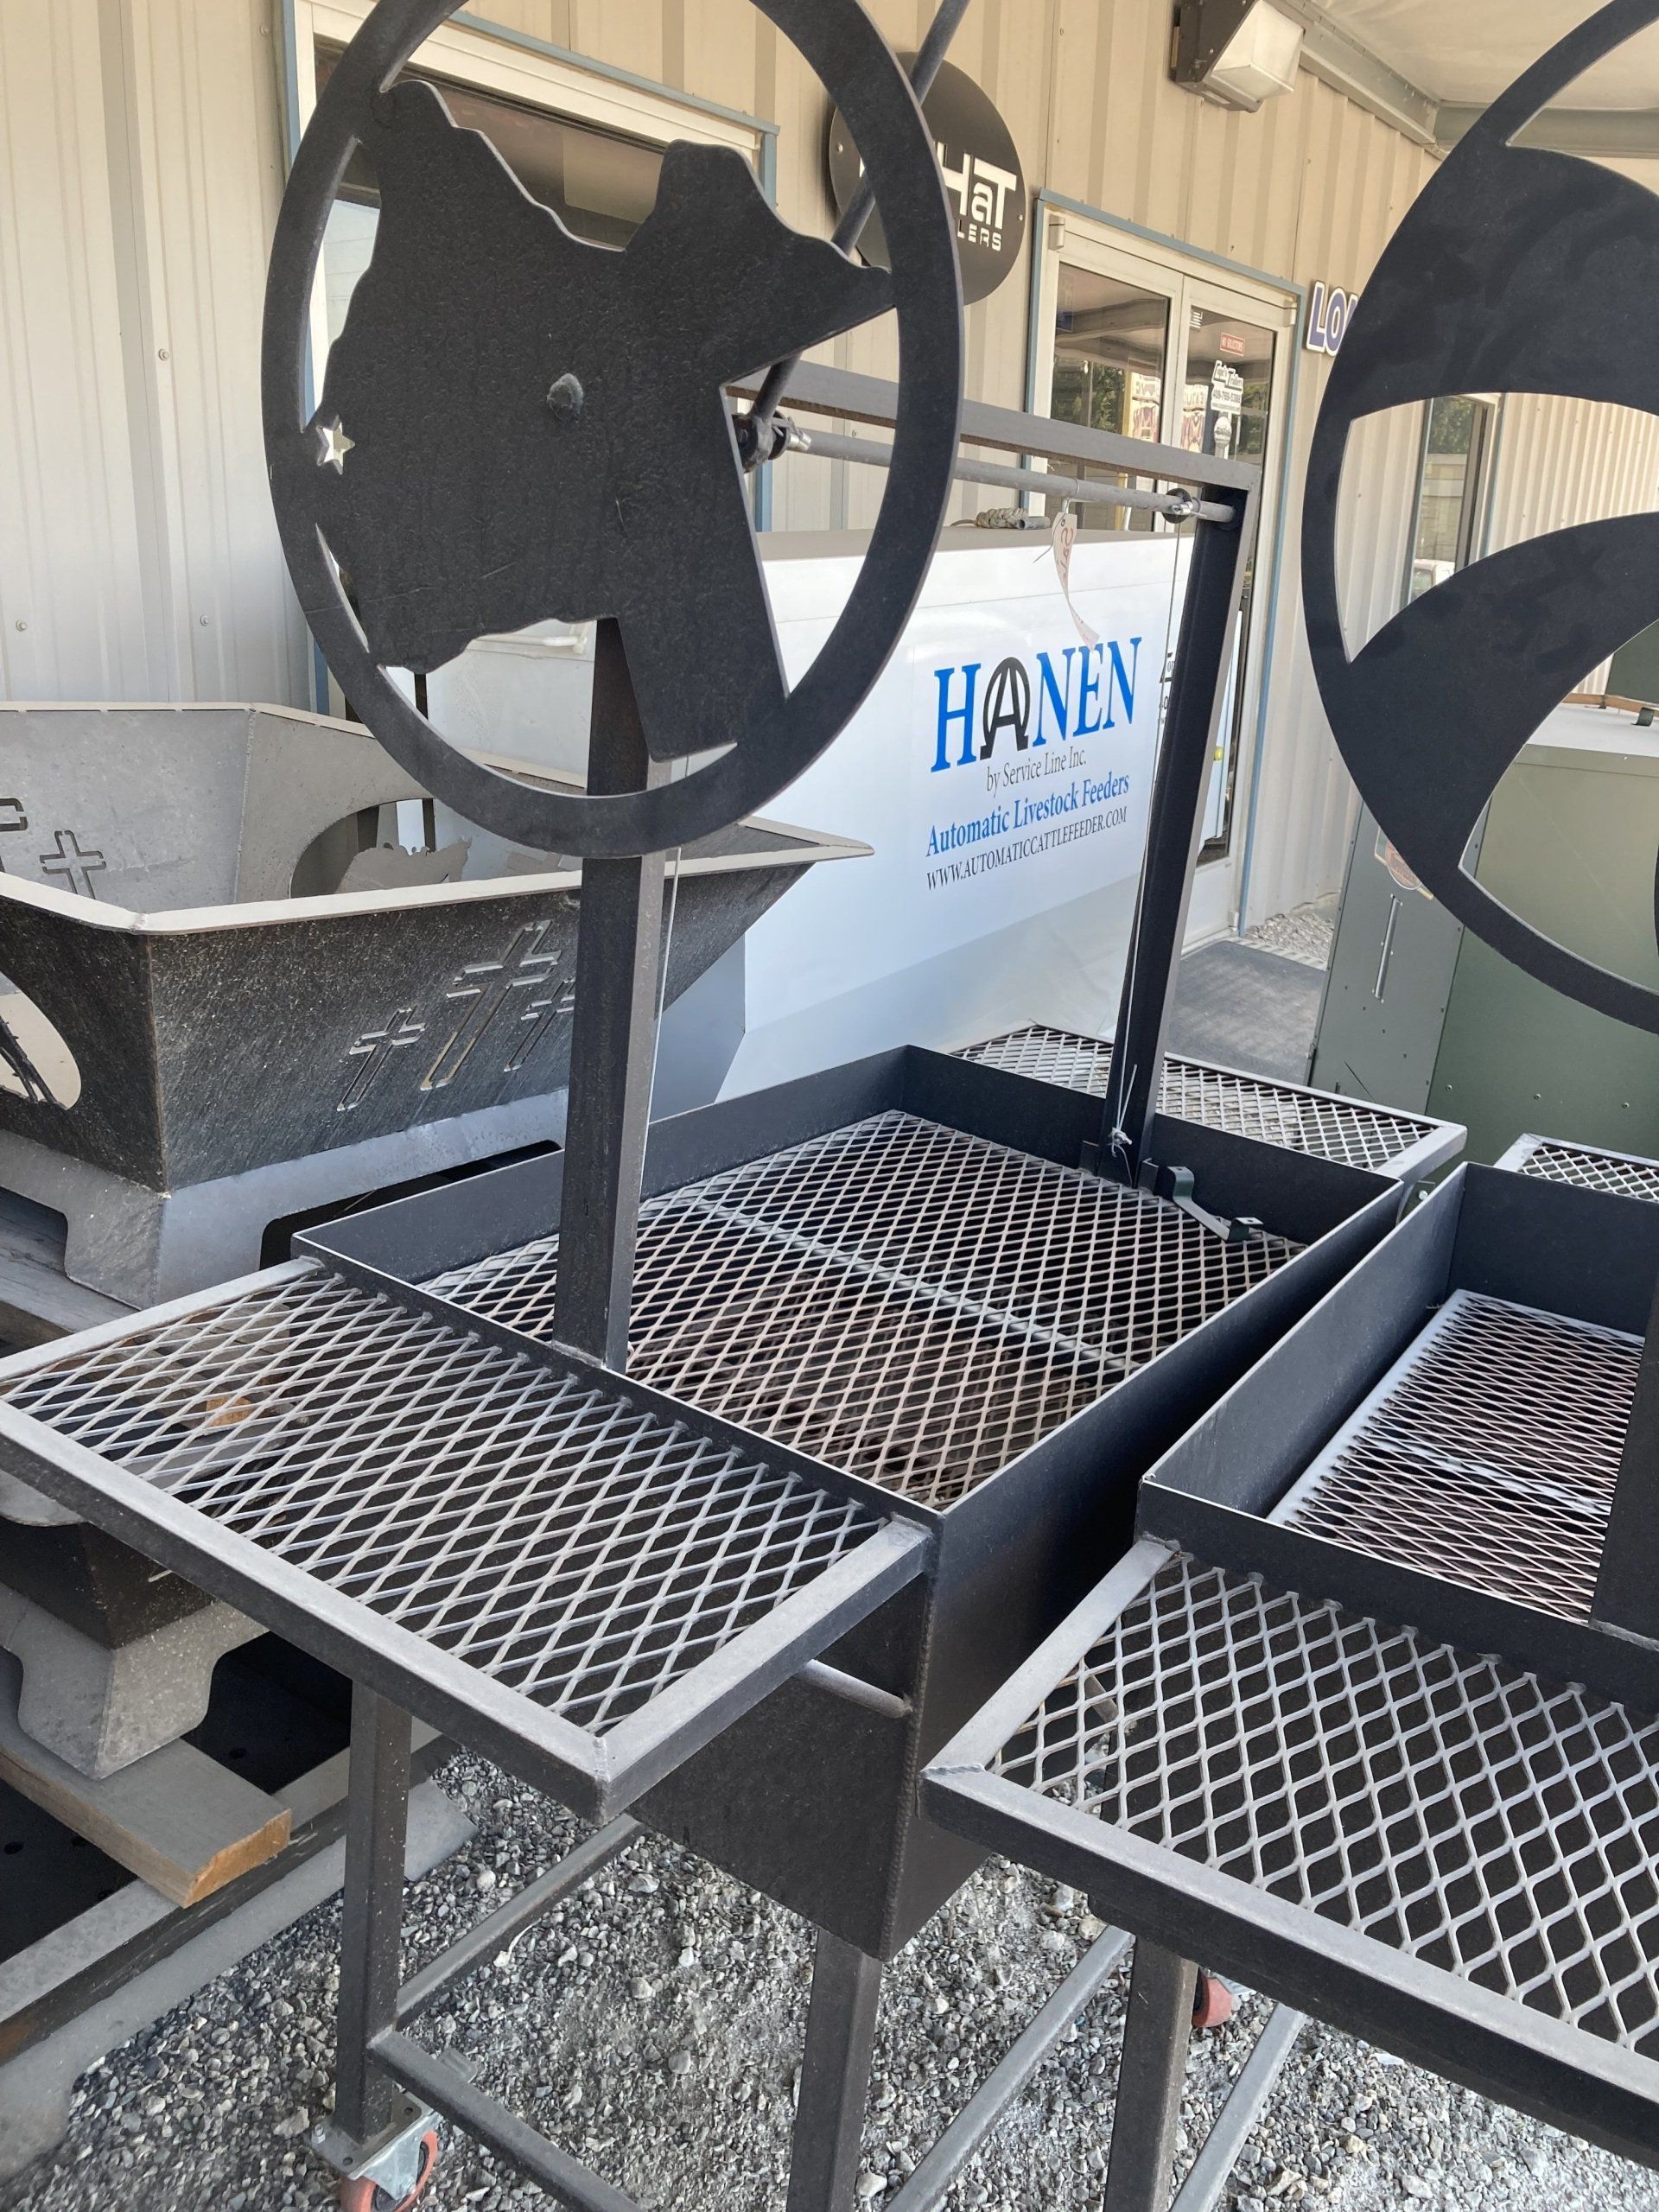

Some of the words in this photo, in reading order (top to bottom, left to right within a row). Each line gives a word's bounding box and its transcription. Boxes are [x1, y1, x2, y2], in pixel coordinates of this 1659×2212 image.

[931, 637, 1142, 772] HANEN
[925, 804, 1010, 857] Automatic
[1014, 781, 1079, 830] Livestock
[1082, 771, 1129, 807] Feeders
[987, 766, 1001, 798] by
[1003, 758, 1042, 787] Service
[1044, 752, 1066, 776] Line
[1069, 746, 1087, 768] Inc.
[926, 806, 1128, 891] WWW.AUTOMATICCATTLEFEEDER.COM
